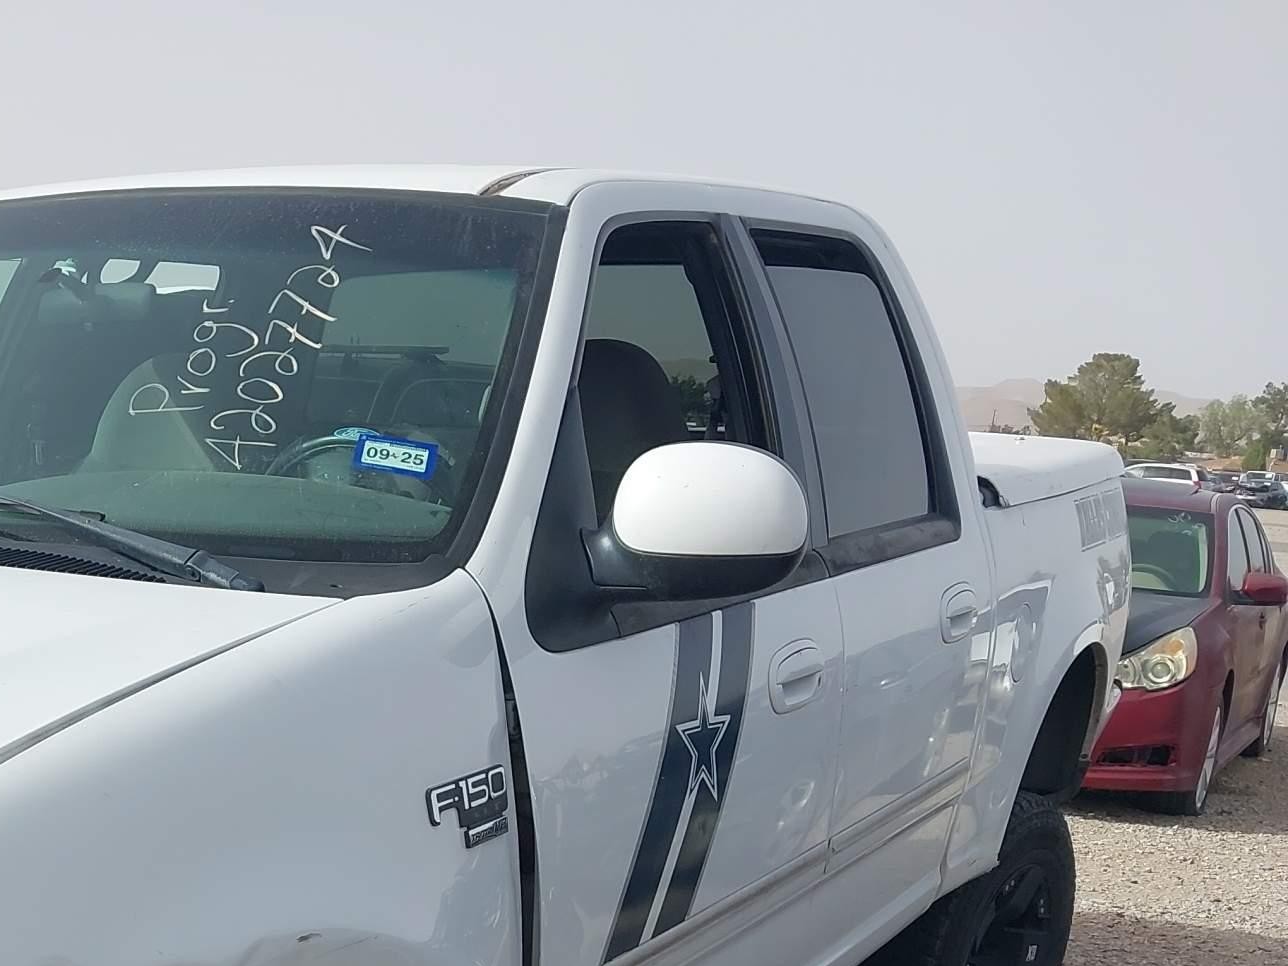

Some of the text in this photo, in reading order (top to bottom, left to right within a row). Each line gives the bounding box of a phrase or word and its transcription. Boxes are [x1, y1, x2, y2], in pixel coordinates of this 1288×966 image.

[205, 225, 373, 470] 42027724
[366, 446, 391, 461] 09
[400, 451, 425, 466] 25
